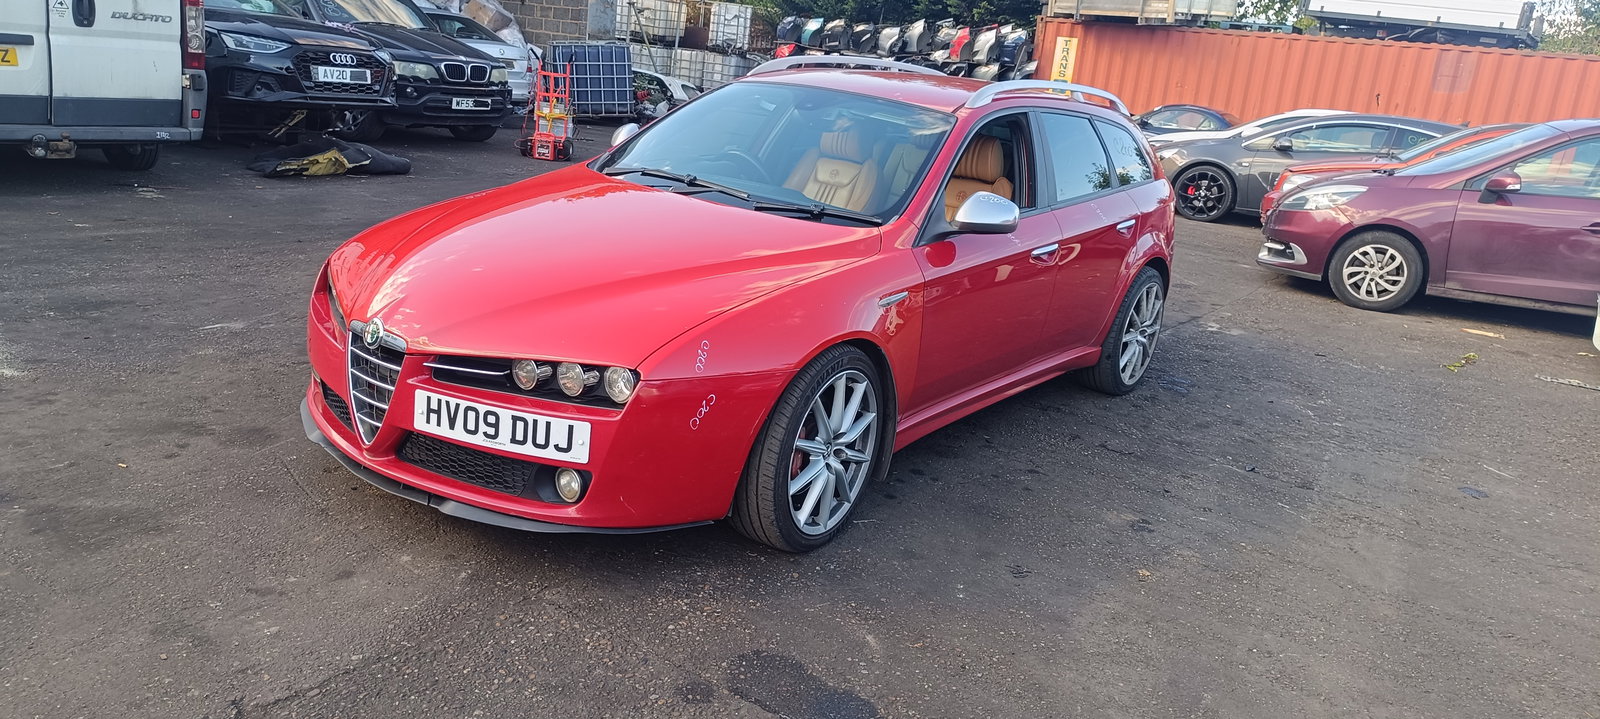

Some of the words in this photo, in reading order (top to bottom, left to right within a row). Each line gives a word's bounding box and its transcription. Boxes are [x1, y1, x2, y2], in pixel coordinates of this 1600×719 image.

[110, 11, 172, 23] DUCATO
[1058, 39, 1071, 78] TRANS
[322, 68, 348, 80] AV20
[425, 395, 500, 440] HV09
[509, 414, 574, 453] DUJ
